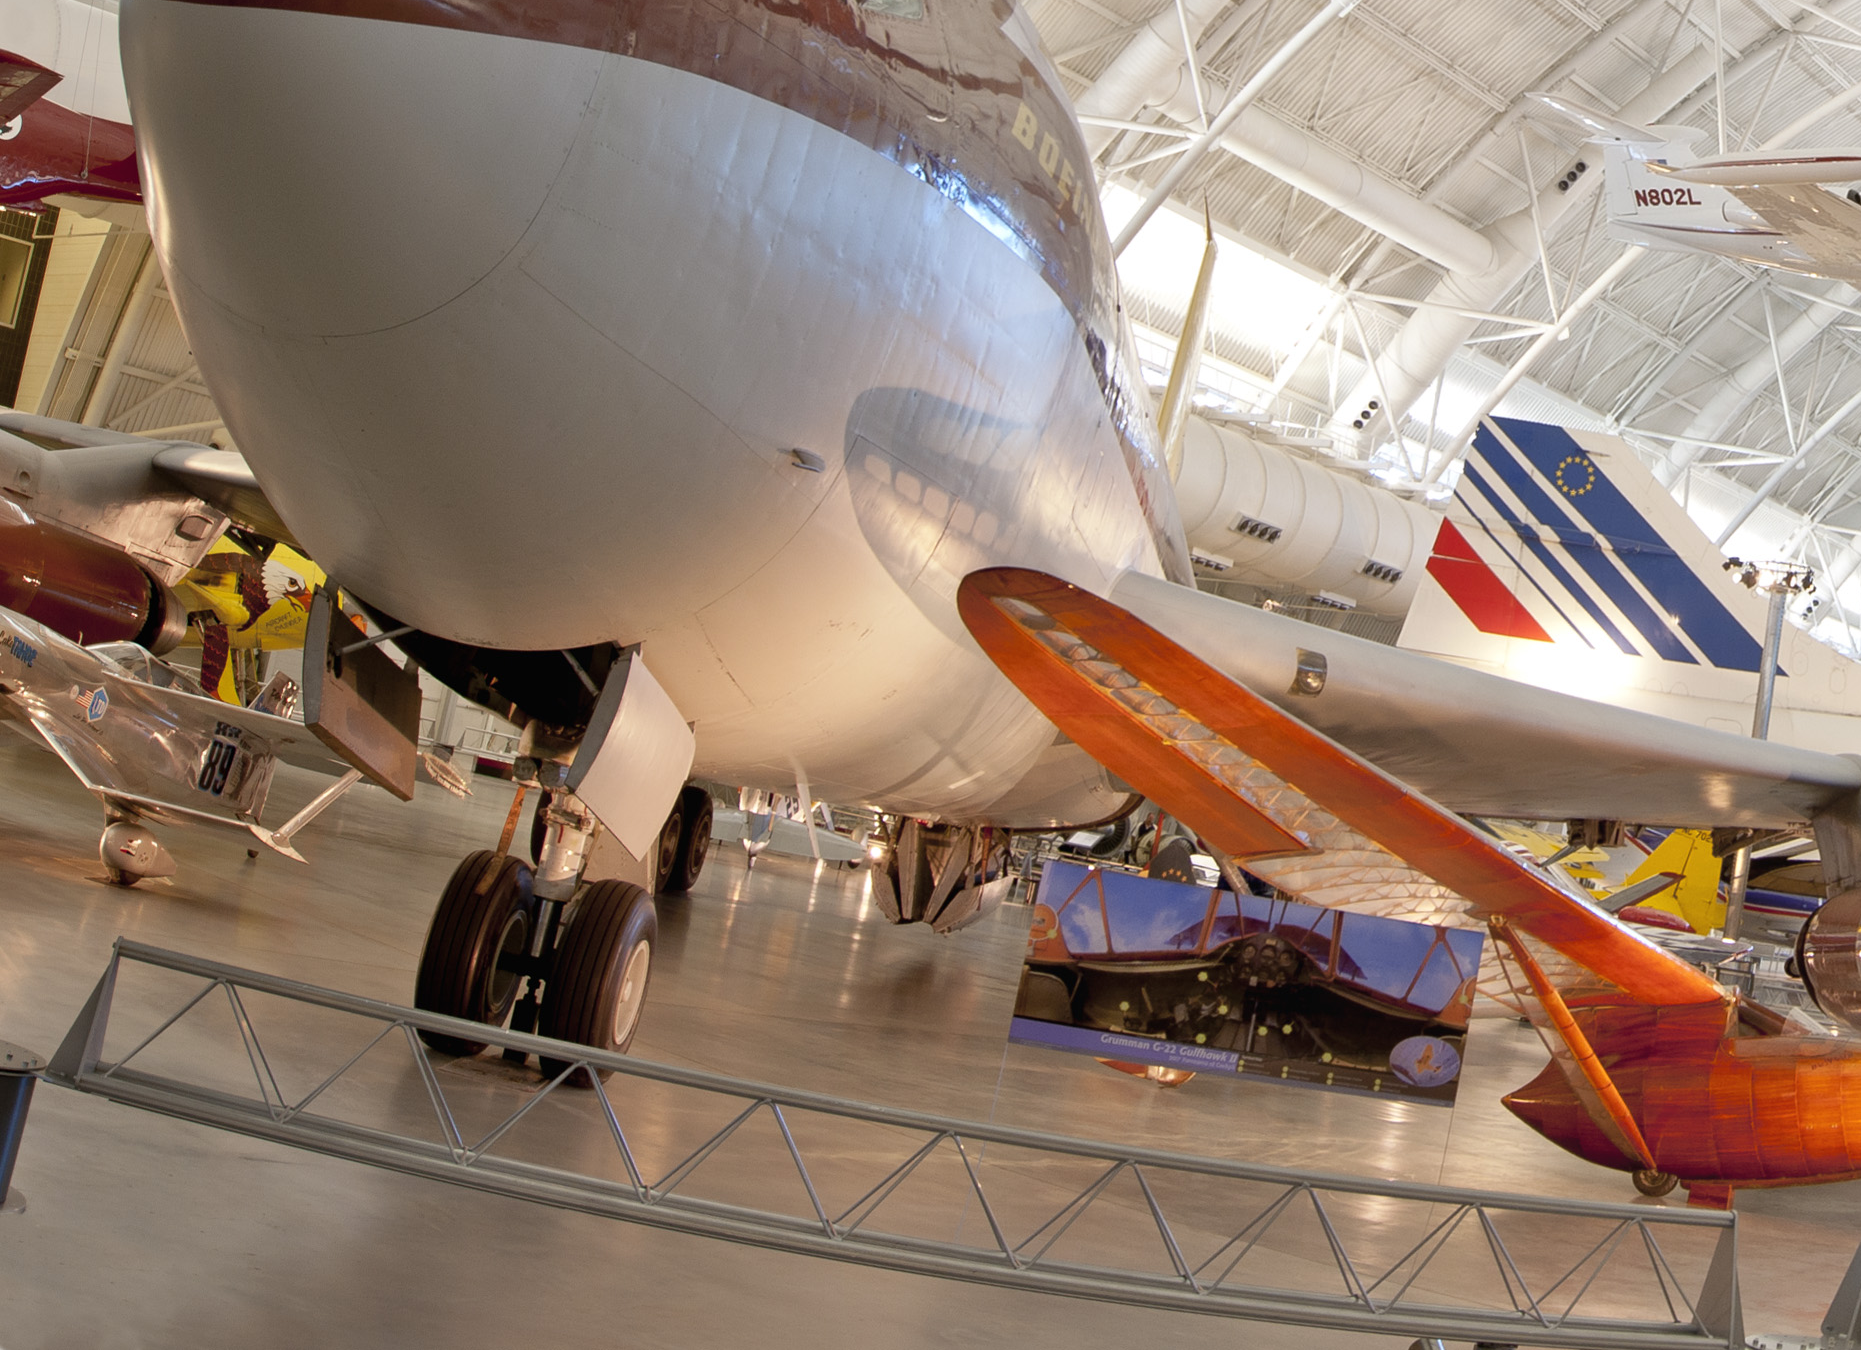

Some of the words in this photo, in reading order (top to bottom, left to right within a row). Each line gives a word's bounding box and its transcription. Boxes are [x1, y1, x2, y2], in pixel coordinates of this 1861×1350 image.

[1634, 188, 1702, 207] N802L
[198, 739, 237, 797] 89
[1100, 1033, 1150, 1051] Grumman
[1152, 1041, 1176, 1054] G-22
[1179, 1046, 1228, 1063] Gulfhawk
[1227, 1052, 1239, 1065] II
